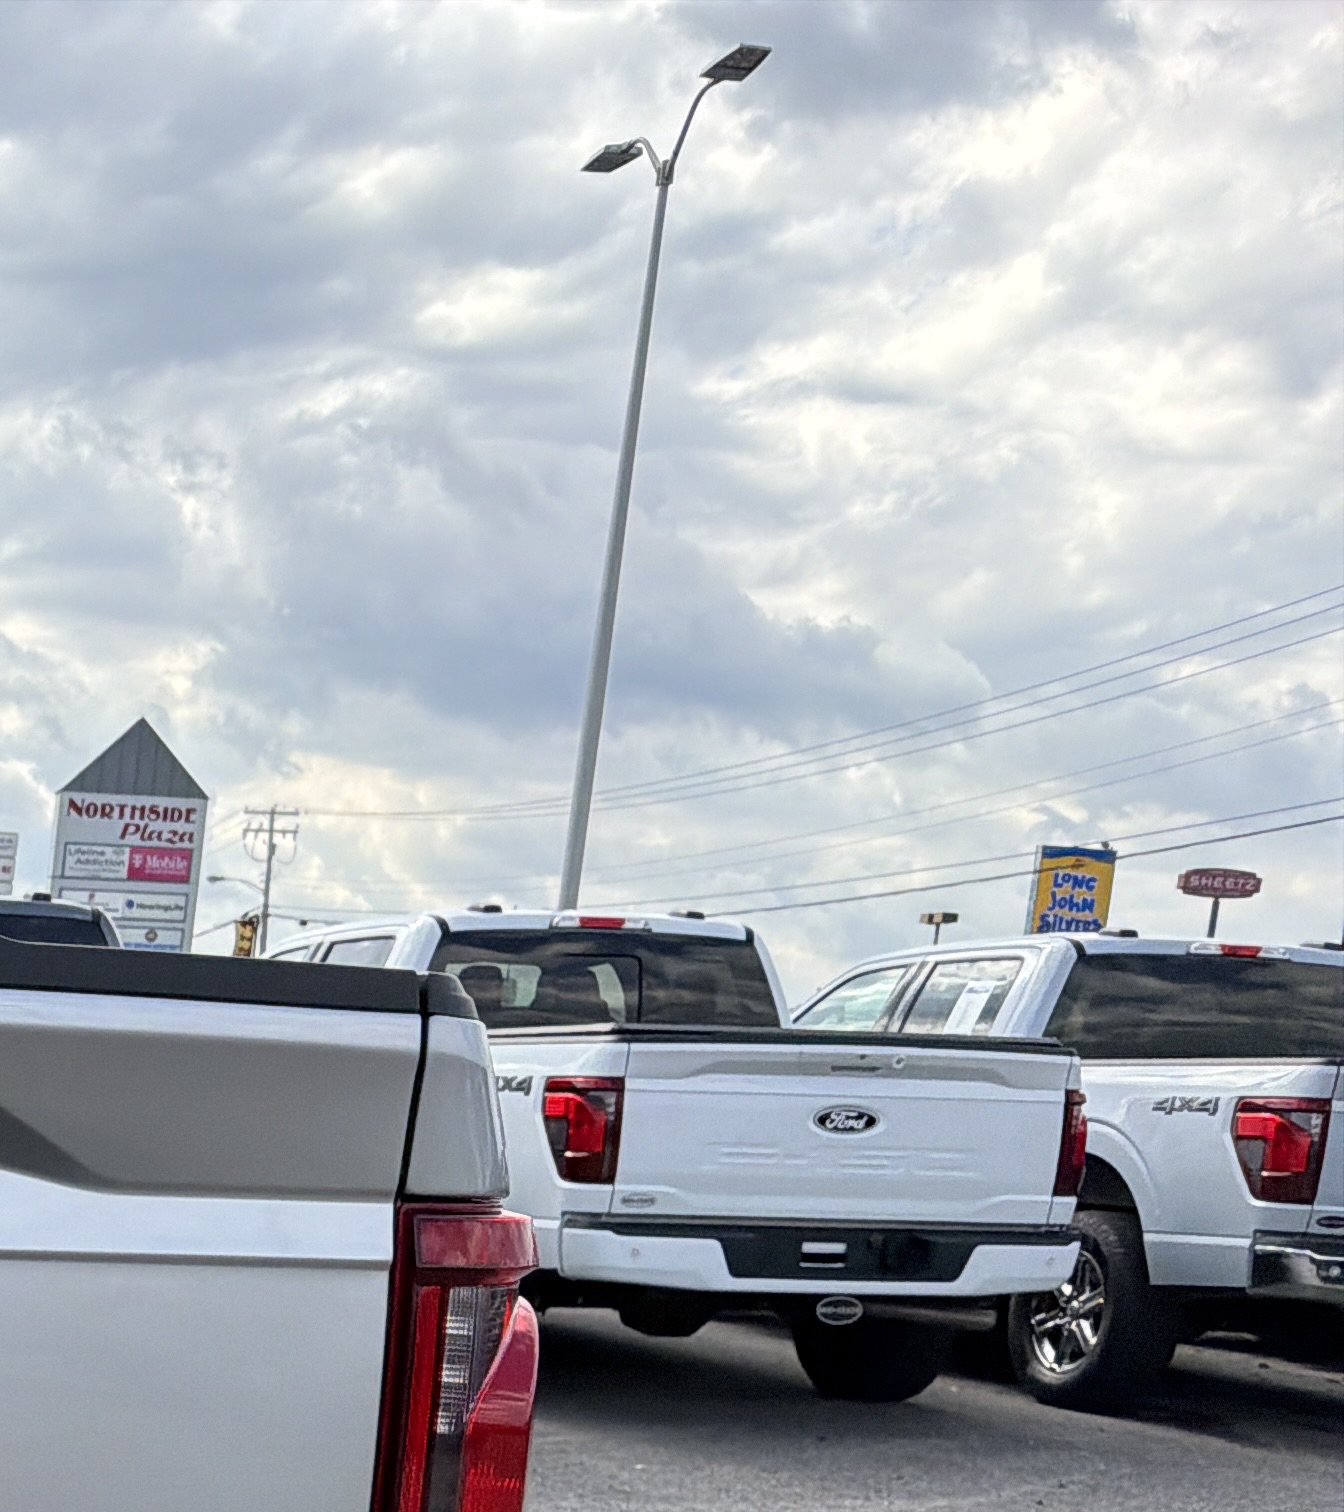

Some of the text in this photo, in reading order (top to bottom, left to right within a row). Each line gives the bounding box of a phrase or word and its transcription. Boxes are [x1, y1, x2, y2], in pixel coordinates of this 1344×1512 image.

[67, 798, 197, 824] NORTHSIDE
[119, 822, 195, 845] Plaza
[145, 854, 188, 870] Mobile
[1189, 875, 1257, 891] SHEETZ
[825, 1111, 869, 1129] Ford
